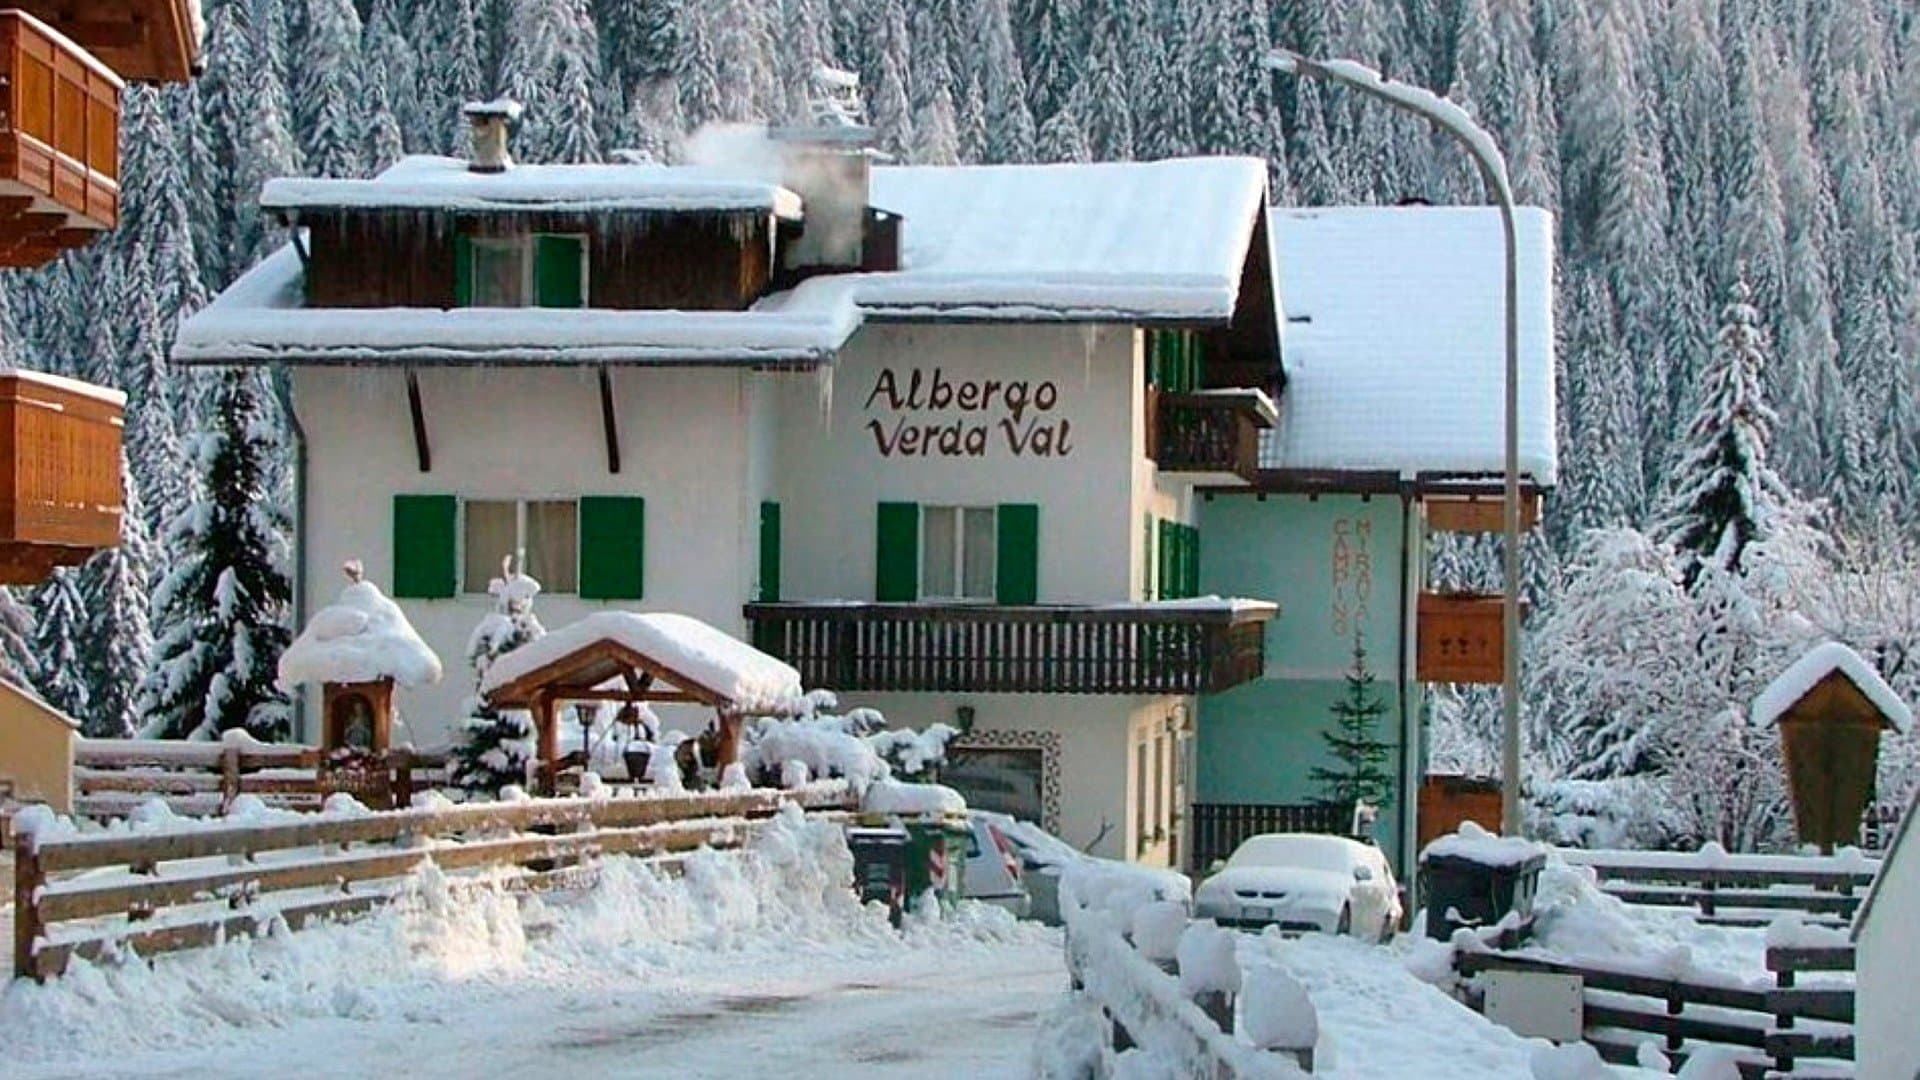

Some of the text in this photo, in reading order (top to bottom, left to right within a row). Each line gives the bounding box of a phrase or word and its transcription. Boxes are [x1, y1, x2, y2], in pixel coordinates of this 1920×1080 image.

[865, 367, 1057, 424] Albergo
[865, 417, 1073, 457] Verda Val
